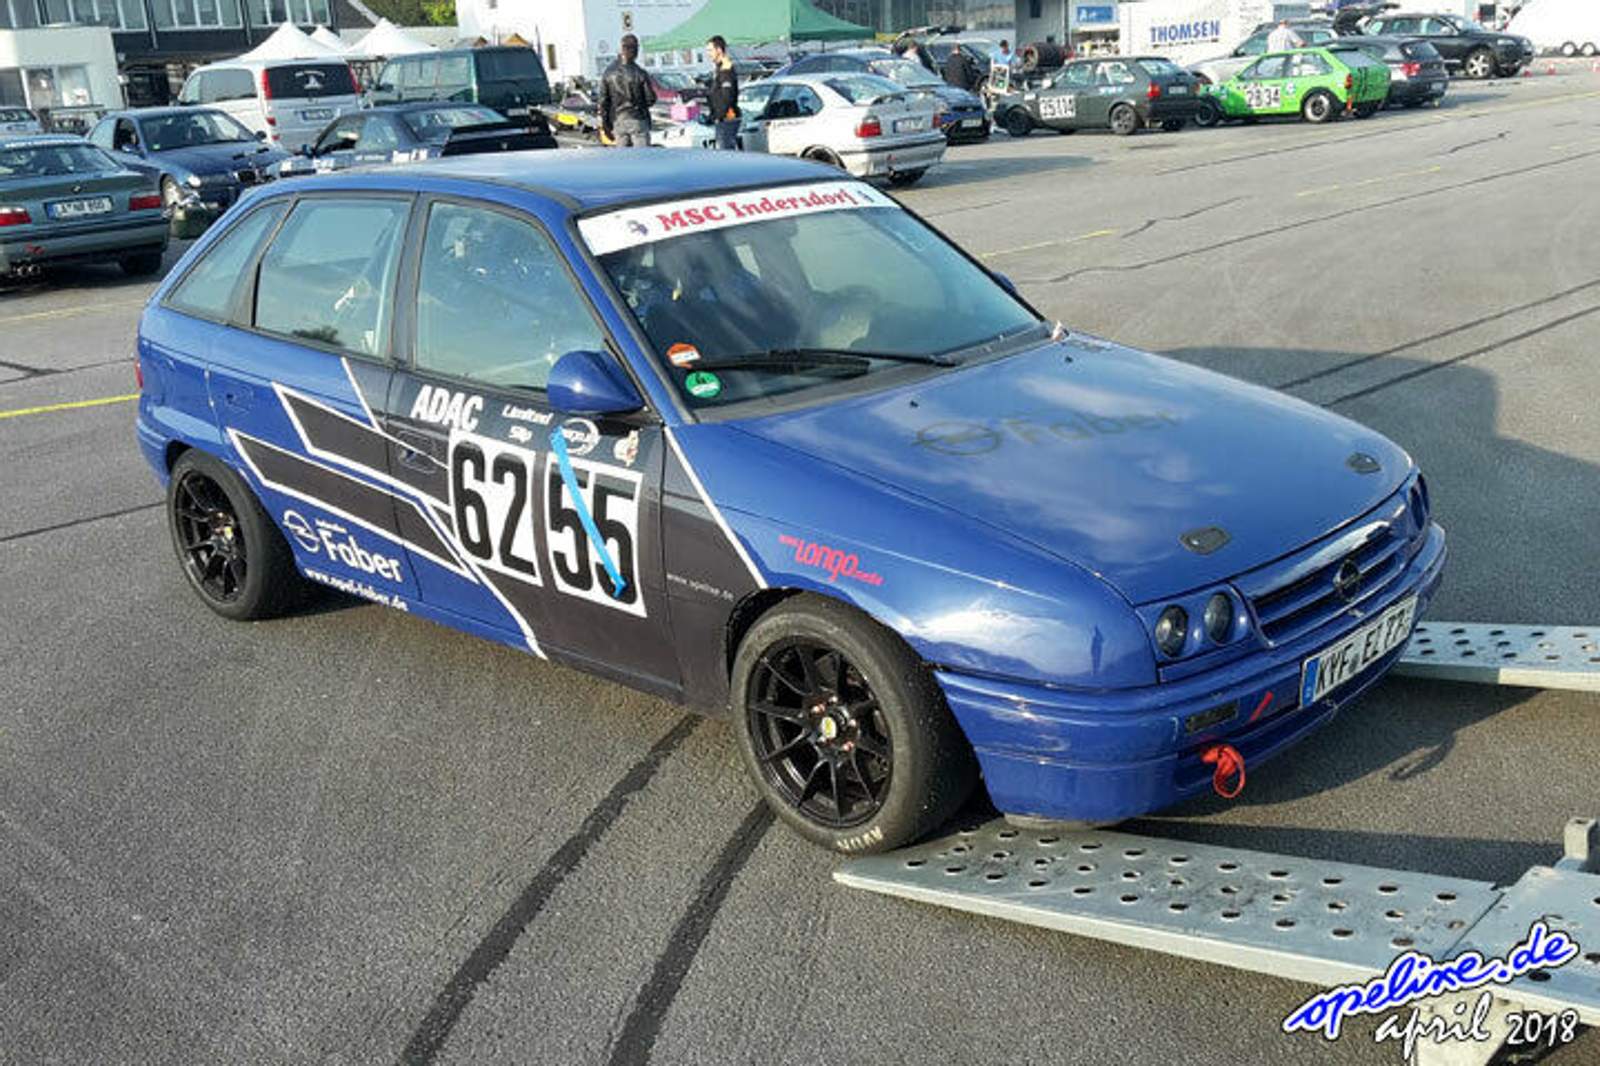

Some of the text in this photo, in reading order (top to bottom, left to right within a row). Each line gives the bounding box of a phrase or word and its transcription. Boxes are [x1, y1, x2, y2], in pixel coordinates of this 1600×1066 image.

[1150, 20, 1221, 43] THOMSEN
[656, 188, 859, 231] MSC Indersdorf
[410, 385, 484, 432] ADAC
[452, 440, 638, 605] 62 55
[318, 528, 403, 583] Faber
[1315, 643, 1354, 694] KYF
